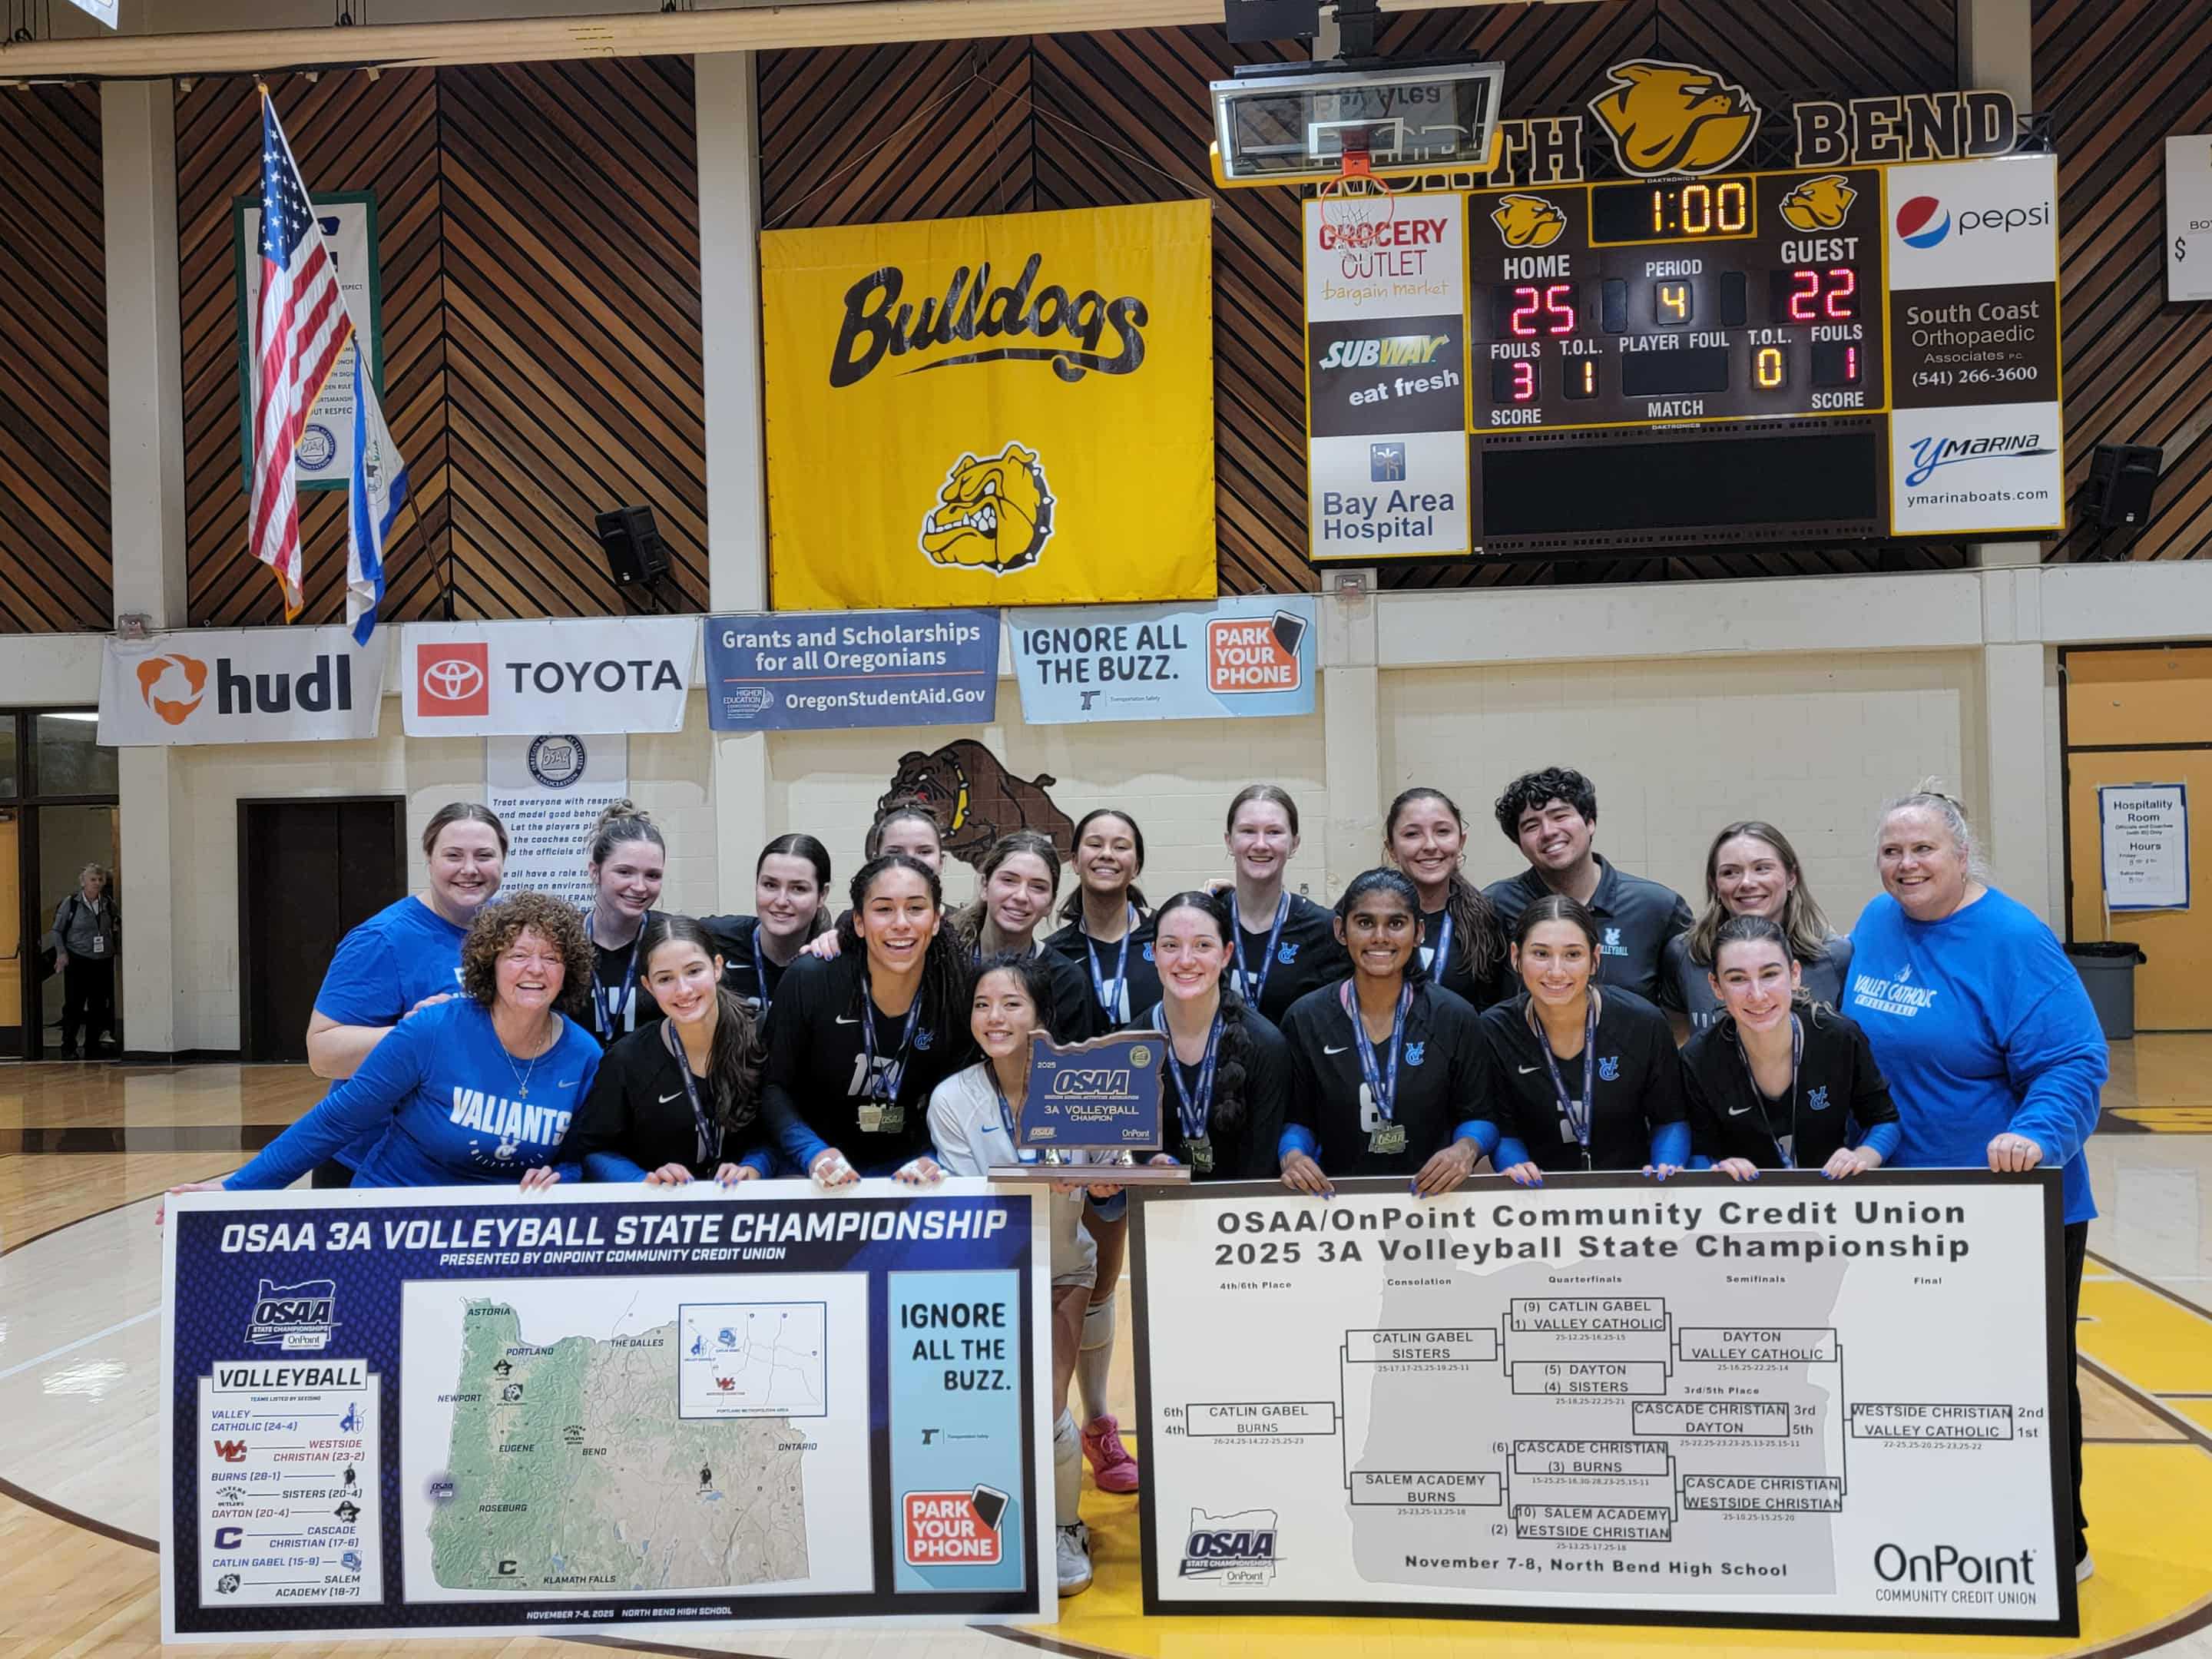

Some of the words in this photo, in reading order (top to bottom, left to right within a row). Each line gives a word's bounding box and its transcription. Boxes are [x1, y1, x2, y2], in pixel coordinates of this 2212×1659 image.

[1794, 90, 2016, 168] BEND
[1654, 183, 1746, 233] 1:00
[1959, 202, 2049, 235] pepsi
[1320, 219, 1448, 250] GROCERY
[1780, 237, 1858, 263] GUEST
[1342, 250, 1427, 280] OUTLET
[1504, 255, 1571, 280] HOME
[1646, 260, 1702, 278] PERIOD
[1322, 280, 1389, 306] bargain
[1392, 282, 1449, 297] market
[1662, 286, 1685, 318] 4
[1791, 269, 1855, 320] 22
[830, 253, 1148, 388] Bulldogs
[1512, 286, 1574, 334] 25
[1907, 304, 1965, 326] South
[1973, 300, 2039, 322] Coast
[1619, 334, 1680, 353] PLAYER
[1690, 330, 1730, 348] FOUL
[1748, 329, 1792, 346] T.O.L.
[1811, 325, 1863, 343] FOULS
[1912, 325, 2035, 348] Orthopaedic
[1320, 334, 1449, 370] SUBWAY
[1491, 343, 1541, 359] FOULS
[1560, 340, 1603, 355] T.O.L.
[1924, 351, 2005, 364] Associates
[1759, 349, 1780, 386] 0
[1848, 347, 1855, 379] 1
[1515, 363, 1532, 399] 3
[1585, 361, 1591, 392] 1
[1912, 369, 1954, 388] (541)
[1959, 367, 2038, 384] 266-3600
[1349, 381, 1389, 406] eat
[1396, 369, 1459, 396] fresh
[1648, 400, 1704, 418] MATCH
[1812, 392, 1864, 409] SCORE
[1492, 409, 1541, 425] SCORE
[1323, 492, 1378, 520] Bay
[1387, 490, 1454, 512] Area
[1907, 488, 2048, 506] ymarinaboats.com
[1324, 516, 1433, 542] Hospital
[722, 631, 791, 648] Grants
[797, 628, 836, 647] and
[843, 622, 980, 645] Scholarships
[1024, 626, 1128, 655] IGNORE
[1137, 624, 1187, 651] ALL
[1217, 627, 1270, 646] PARK
[756, 653, 786, 671] for
[793, 651, 818, 671] all
[823, 649, 946, 672] Oregonians
[1217, 647, 1274, 666] YOUR
[506, 660, 683, 693] TOYOTA
[1037, 657, 1090, 685] THE
[1098, 655, 1178, 680] BUZZ.
[1217, 664, 1291, 684] PHONE
[217, 654, 352, 714] hudl
[786, 688, 985, 711] OregonStudentAid.Gov
[549, 811, 571, 820] good
[2114, 800, 2173, 811] Hospitality
[546, 823, 580, 832] players
[2128, 813, 2160, 822] Room
[1854, 975, 1890, 998] VALLEY
[1888, 984, 1937, 1008] CATHOLIC
[1053, 1069, 1130, 1094] OSAA
[450, 1086, 571, 1146] VALIANTS
[1065, 1106, 1138, 1114] VOLLEYBALL
[1217, 1207, 1475, 1234] OSAA/OnPoint
[1492, 1203, 1702, 1230] Community
[1719, 1201, 1837, 1224] Credit
[1855, 1201, 1965, 1224] Union
[220, 1223, 316, 1253] OSAA
[326, 1223, 372, 1250] 3A
[384, 1217, 605, 1250] VOLLEYBALL
[615, 1214, 724, 1245] STATE
[730, 1210, 1007, 1243] CHAMPIONSHIP
[439, 1253, 520, 1267] PRESENTED
[524, 1253, 541, 1264] BY
[543, 1250, 601, 1264] ONPOINT
[606, 1249, 689, 1263] COMMUNITY
[691, 1248, 740, 1260] CREDIT
[743, 1247, 786, 1260] UNION
[1215, 1243, 1301, 1265] 2025
[1318, 1241, 1362, 1262] 3A
[1379, 1237, 1561, 1264] Volleyball
[1579, 1235, 1678, 1258] State
[1695, 1234, 1969, 1262] Championship
[1387, 1277, 1451, 1286] Consolation
[254, 1299, 334, 1325] OSAA
[902, 1303, 1005, 1328] IGNORE
[1373, 1333, 1422, 1343] CATLIN
[1426, 1332, 1473, 1343] GABEL
[1724, 1332, 1781, 1342] DAYTON
[912, 1339, 955, 1360] ALL
[961, 1339, 1005, 1359] THE
[1392, 1349, 1450, 1359] SISTERS
[1692, 1349, 1746, 1359] VALLEY
[1751, 1349, 1823, 1359] CATHOLIC
[220, 1368, 361, 1387] VOLLEYBALL
[945, 1370, 1011, 1390] BUZZ.
[1164, 1407, 1183, 1417] 6th
[1210, 1407, 1257, 1417] CATLIN
[1262, 1406, 1309, 1416] GABEL
[1794, 1406, 1816, 1415] 3rd
[1852, 1406, 1926, 1416] WESTSIDE
[1932, 1407, 2012, 1418] CHRISTIAN
[2018, 1408, 2043, 1418] 2nd
[1166, 1426, 1185, 1435] 4th
[1237, 1424, 1278, 1432] BURNS
[1686, 1422, 1743, 1432] DAYTON
[1793, 1425, 1813, 1435] 5th
[1865, 1426, 1920, 1435] VALLEY
[1926, 1426, 1999, 1436] CATHOLIC
[2017, 1428, 2038, 1437] 1st
[912, 1500, 970, 1518] PARK
[913, 1521, 975, 1537] YOUR
[914, 1539, 992, 1557] PHONE
[1186, 1530, 1277, 1559] OSAA
[1406, 1555, 1498, 1569] November
[1508, 1558, 1541, 1573] 7-8,
[1551, 1558, 1604, 1572] North
[1614, 1561, 1661, 1573] Bend
[1669, 1561, 1712, 1577] High
[1721, 1562, 1787, 1577] School
[1874, 1544, 2034, 1584] OnPoint
[1227, 1571, 1263, 1581] OnPoint
[1876, 1589, 1948, 1601] COMMUNITY
[1952, 1591, 1994, 1604] CREDIT
[1998, 1592, 2036, 1604] UNION
